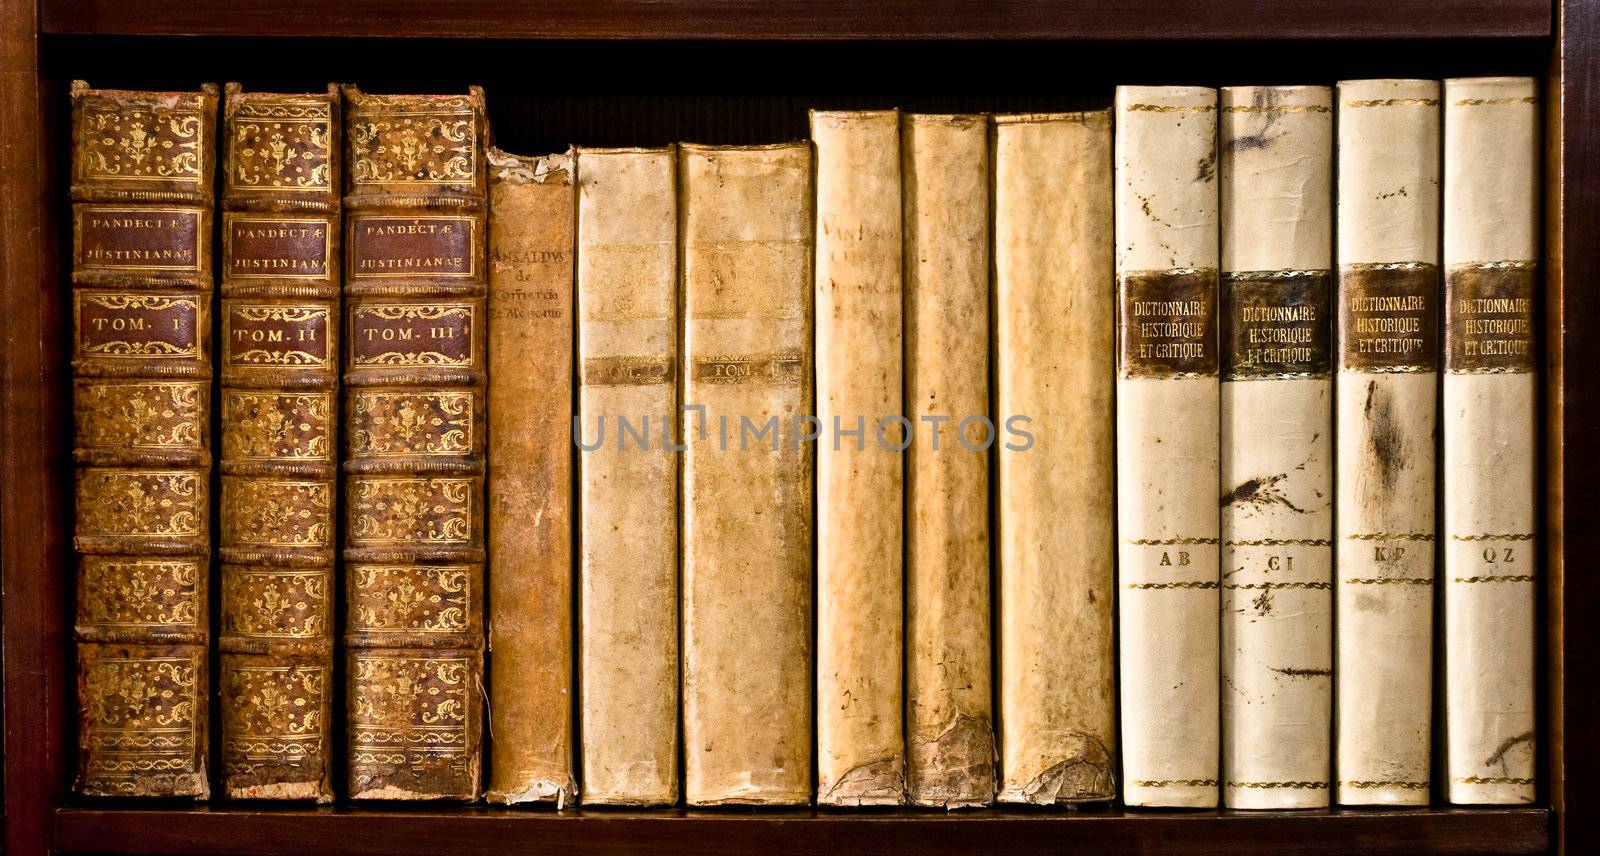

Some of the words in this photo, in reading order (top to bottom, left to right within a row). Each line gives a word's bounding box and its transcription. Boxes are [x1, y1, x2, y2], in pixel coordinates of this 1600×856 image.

[1134, 301, 1207, 316] DICTIONNAIRE
[1352, 295, 1425, 312] DICTIONNAIRE
[1243, 306, 1316, 322] DICTIONNAIRE
[173, 318, 180, 330] I
[431, 326, 453, 338] III
[1141, 322, 1203, 338] HISTORIQUE
[1357, 317, 1420, 333] HISTORIQUE
[1465, 319, 1528, 335] HISTORIQUE
[299, 329, 316, 341] II
[1250, 328, 1312, 344] HISTORIQUE
[1140, 345, 1153, 358] ET
[1156, 343, 1204, 360] CRITIQUE
[1358, 339, 1374, 353] ET
[1464, 341, 1478, 356] ET
[1264, 347, 1312, 364] CRITIQUE
